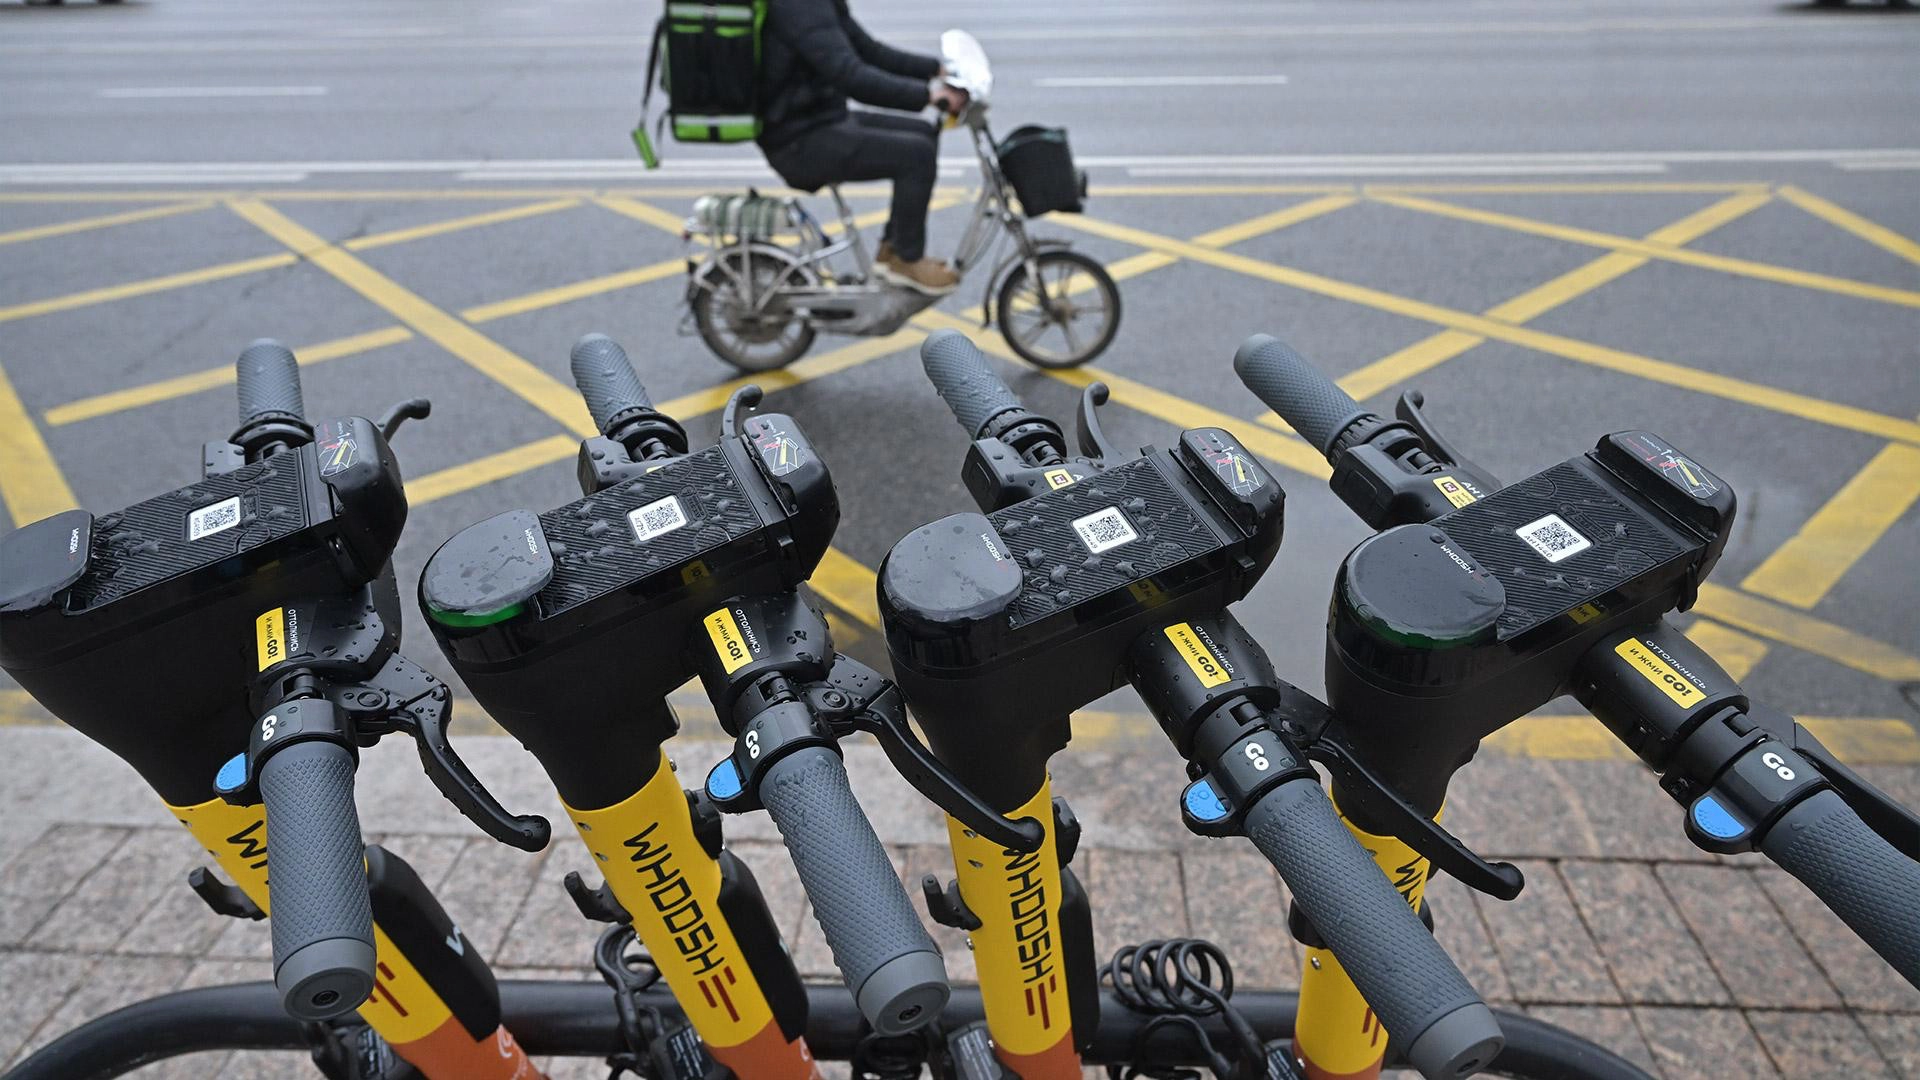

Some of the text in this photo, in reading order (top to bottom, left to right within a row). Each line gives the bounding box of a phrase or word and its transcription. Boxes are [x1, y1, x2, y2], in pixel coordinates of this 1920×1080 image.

[70, 528, 79, 554] WHOOSH
[524, 528, 538, 555] WHOOSH
[981, 533, 1003, 562] WHOOSH
[1440, 545, 1474, 574] WHOOSH
[267, 639, 278, 659] GO!
[288, 609, 299, 652] ОТТОЛКНИСЬ
[727, 640, 743, 661] GO!
[735, 609, 761, 653] ОТТОЛКНИСЬ
[1196, 625, 1235, 674] ОТТОЛКНИСЬ
[1183, 637, 1199, 656] ЖМИ
[1198, 656, 1218, 677] GO!
[1629, 648, 1692, 696] И ЖМИ GO!
[1646, 640, 1706, 689] ОТТОЛКНИСЬ
[623, 822, 725, 976] WHOOSH
[1003, 848, 1054, 983] WHOOSH
